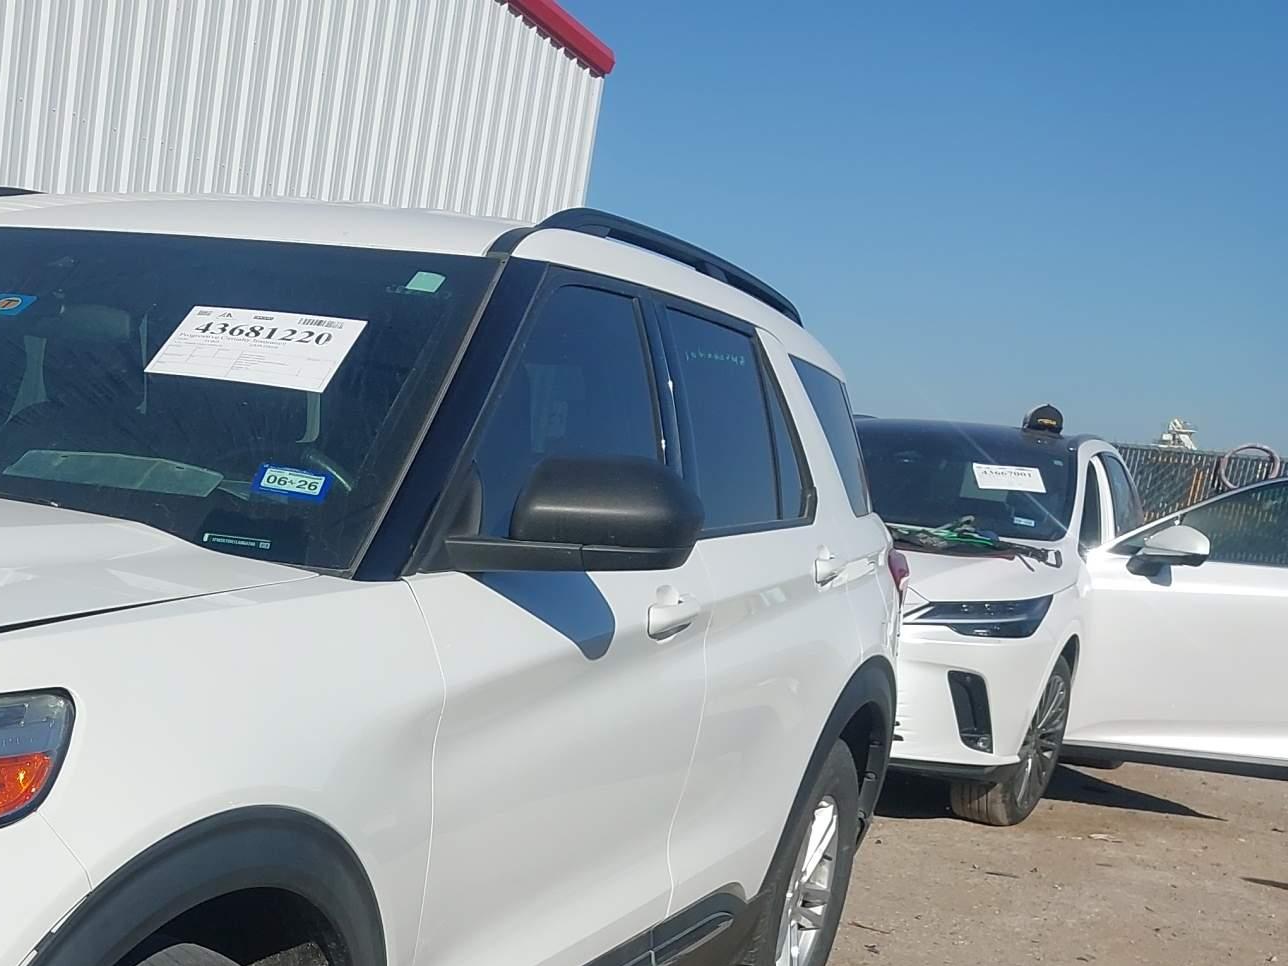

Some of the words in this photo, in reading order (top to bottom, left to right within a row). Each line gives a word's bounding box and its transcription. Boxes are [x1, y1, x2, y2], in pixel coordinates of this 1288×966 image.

[194, 320, 333, 346] 43681220
[266, 474, 288, 486] 06
[296, 479, 319, 491] 26
